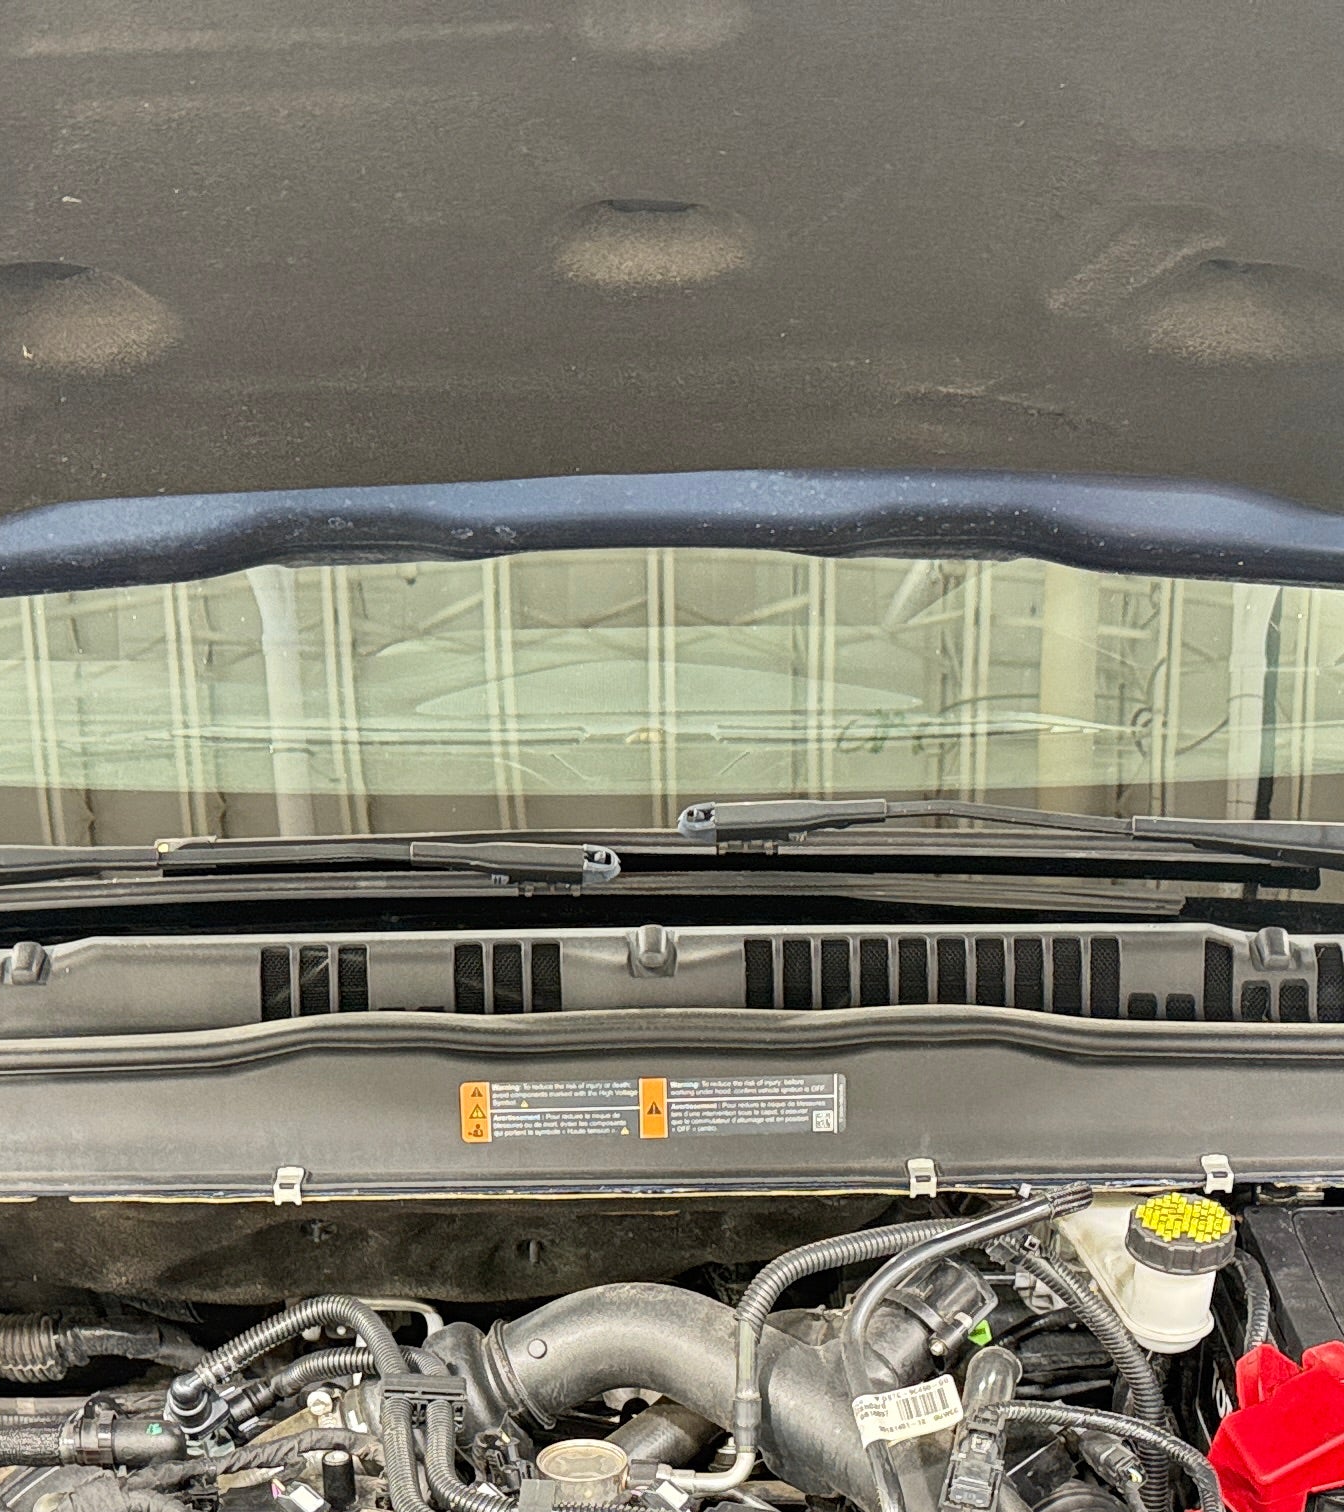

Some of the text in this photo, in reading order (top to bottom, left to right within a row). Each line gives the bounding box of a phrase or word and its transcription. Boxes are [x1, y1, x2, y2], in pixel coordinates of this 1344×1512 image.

[578, 1082, 585, 1090] of
[586, 1082, 602, 1090] injury
[756, 1079, 763, 1087] of
[783, 1078, 804, 1086] before
